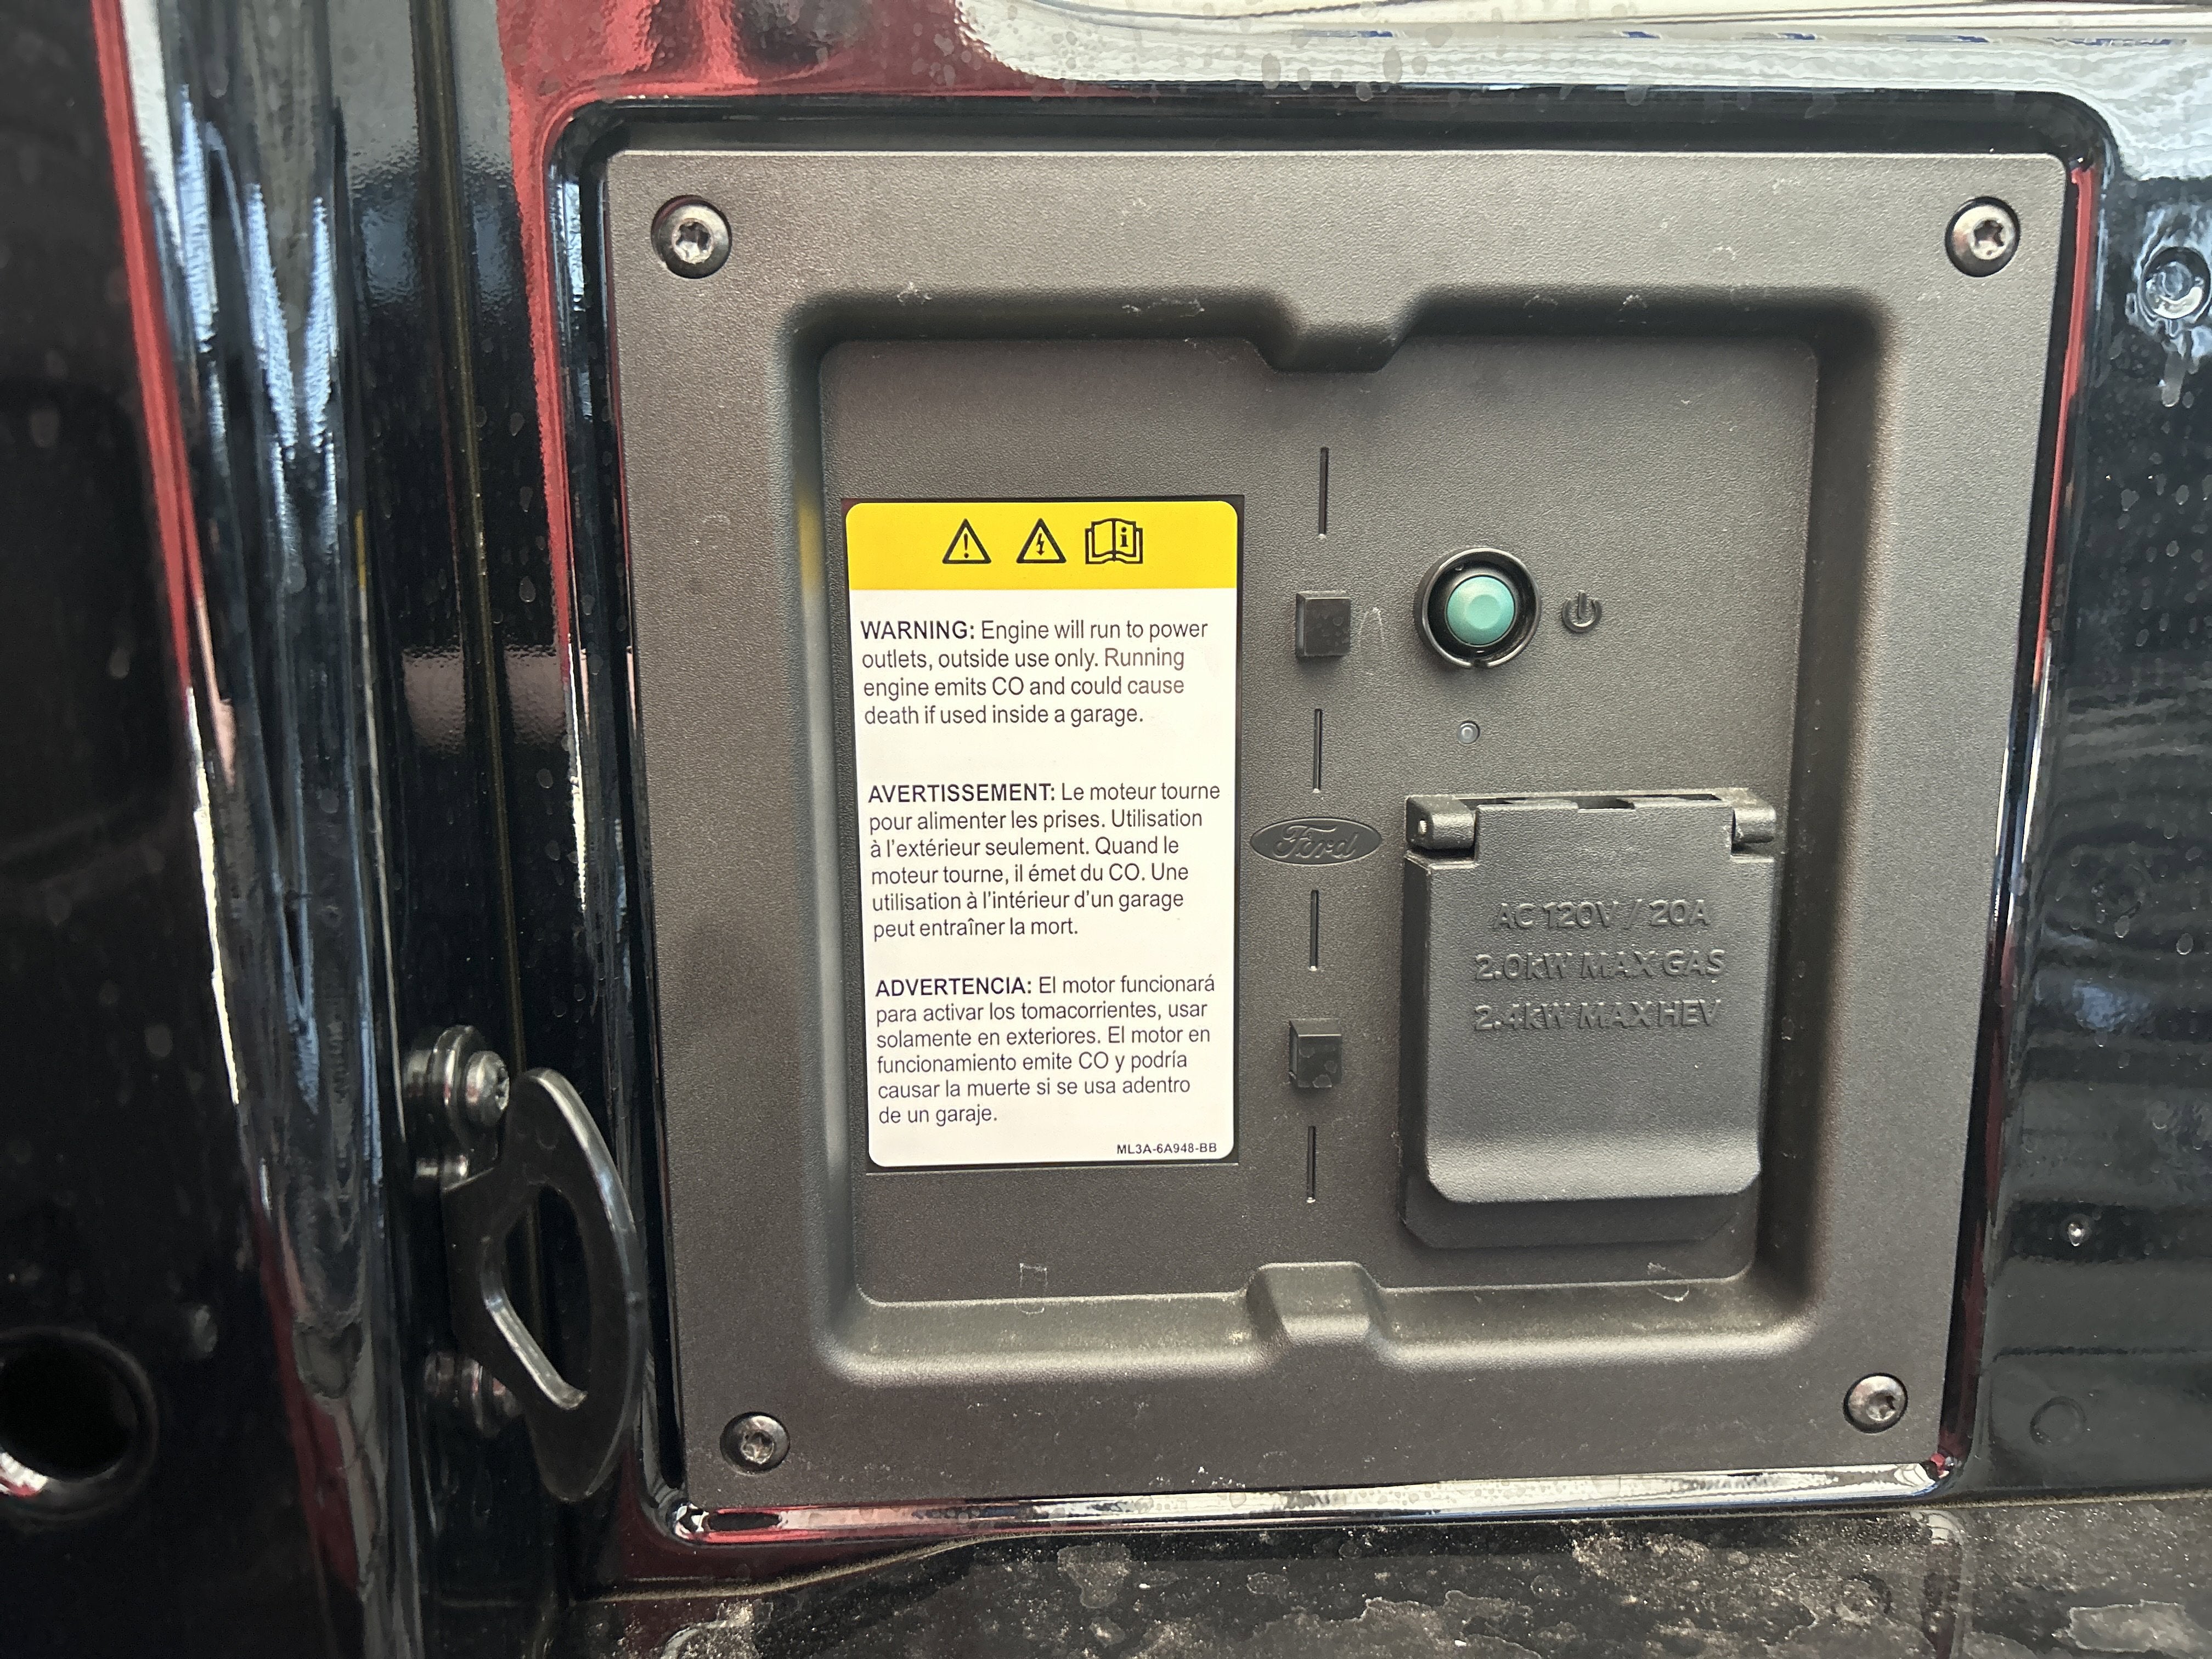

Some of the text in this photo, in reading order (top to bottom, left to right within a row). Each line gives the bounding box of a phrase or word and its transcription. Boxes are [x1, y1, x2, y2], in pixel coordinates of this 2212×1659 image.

[860, 619, 1208, 645] WARNING: Engine will run to power
[862, 647, 1184, 672] outlets, outside use only. Running
[864, 675, 1184, 702] engine emits CO and could cause
[865, 704, 1143, 728] death if used inside a garage.
[867, 782, 1220, 803] AVERTISSEMENT: Le moteur tourne
[870, 808, 1202, 836] pour alimenter les prises. Utilisation
[870, 839, 881, 858] à
[985, 837, 1090, 856] seulement.
[1095, 835, 1158, 855] Quand
[1164, 835, 1179, 854] le
[1272, 825, 1358, 859] Ford
[872, 862, 1188, 885] moteur tourne, il émet du CO. Une
[872, 891, 961, 912] utilisation
[966, 891, 978, 910] à
[1119, 893, 1184, 912] garage
[1493, 899, 1711, 929] AC 120V / 20A
[873, 917, 1078, 943] peut entraîner la mort.
[1475, 949, 1726, 980] 2.0kW MAX GAS
[874, 973, 1215, 997] ADVERTENCIA: El motor funcionará
[877, 1000, 1208, 1028] para activar los tomacorrientes, usar
[1475, 999, 1722, 1030] 2.4kW MAX HEV
[877, 1025, 1210, 1048] solamente en exteriores. El motor en
[877, 1049, 1187, 1074] funcionamiento emite CO y podría
[878, 1075, 1190, 1099] causar la muerte si se usa adentro
[879, 1103, 997, 1127] de un garaje.
[1117, 1143, 1217, 1154] ML3A-6A948-BB
